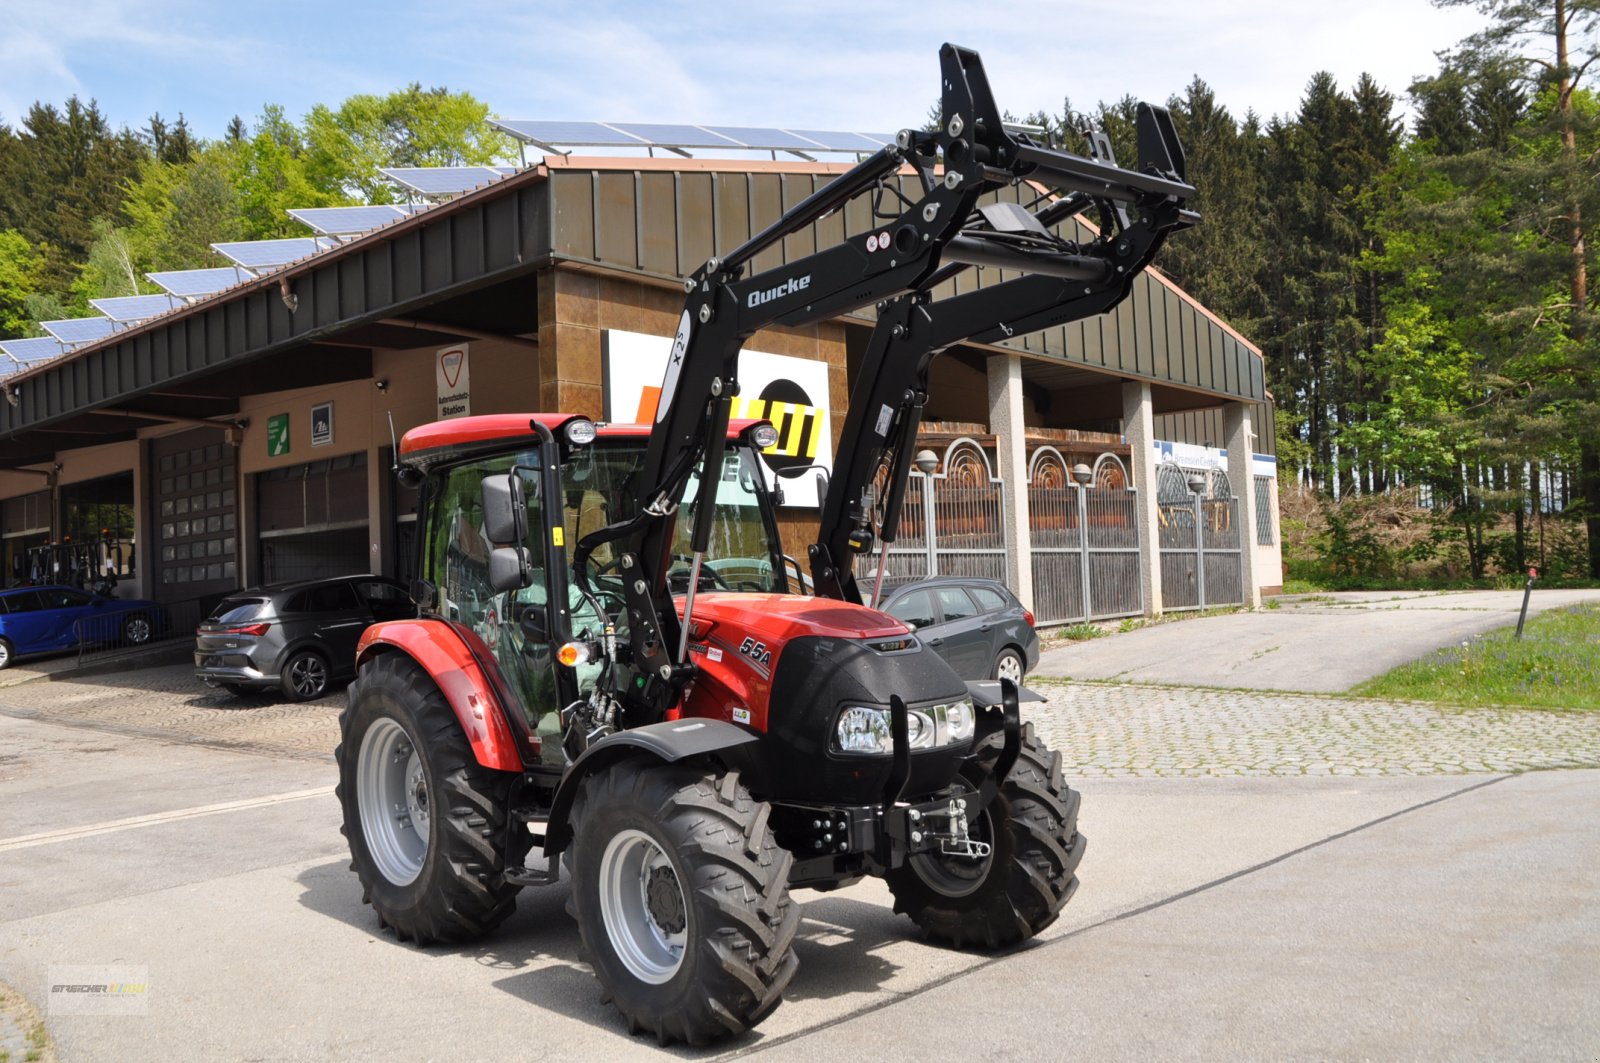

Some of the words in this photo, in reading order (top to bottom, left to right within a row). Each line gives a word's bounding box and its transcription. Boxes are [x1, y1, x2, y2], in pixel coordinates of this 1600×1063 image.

[748, 273, 812, 309] Quicke
[442, 404, 466, 417] Station
[739, 636, 771, 666] 55A
